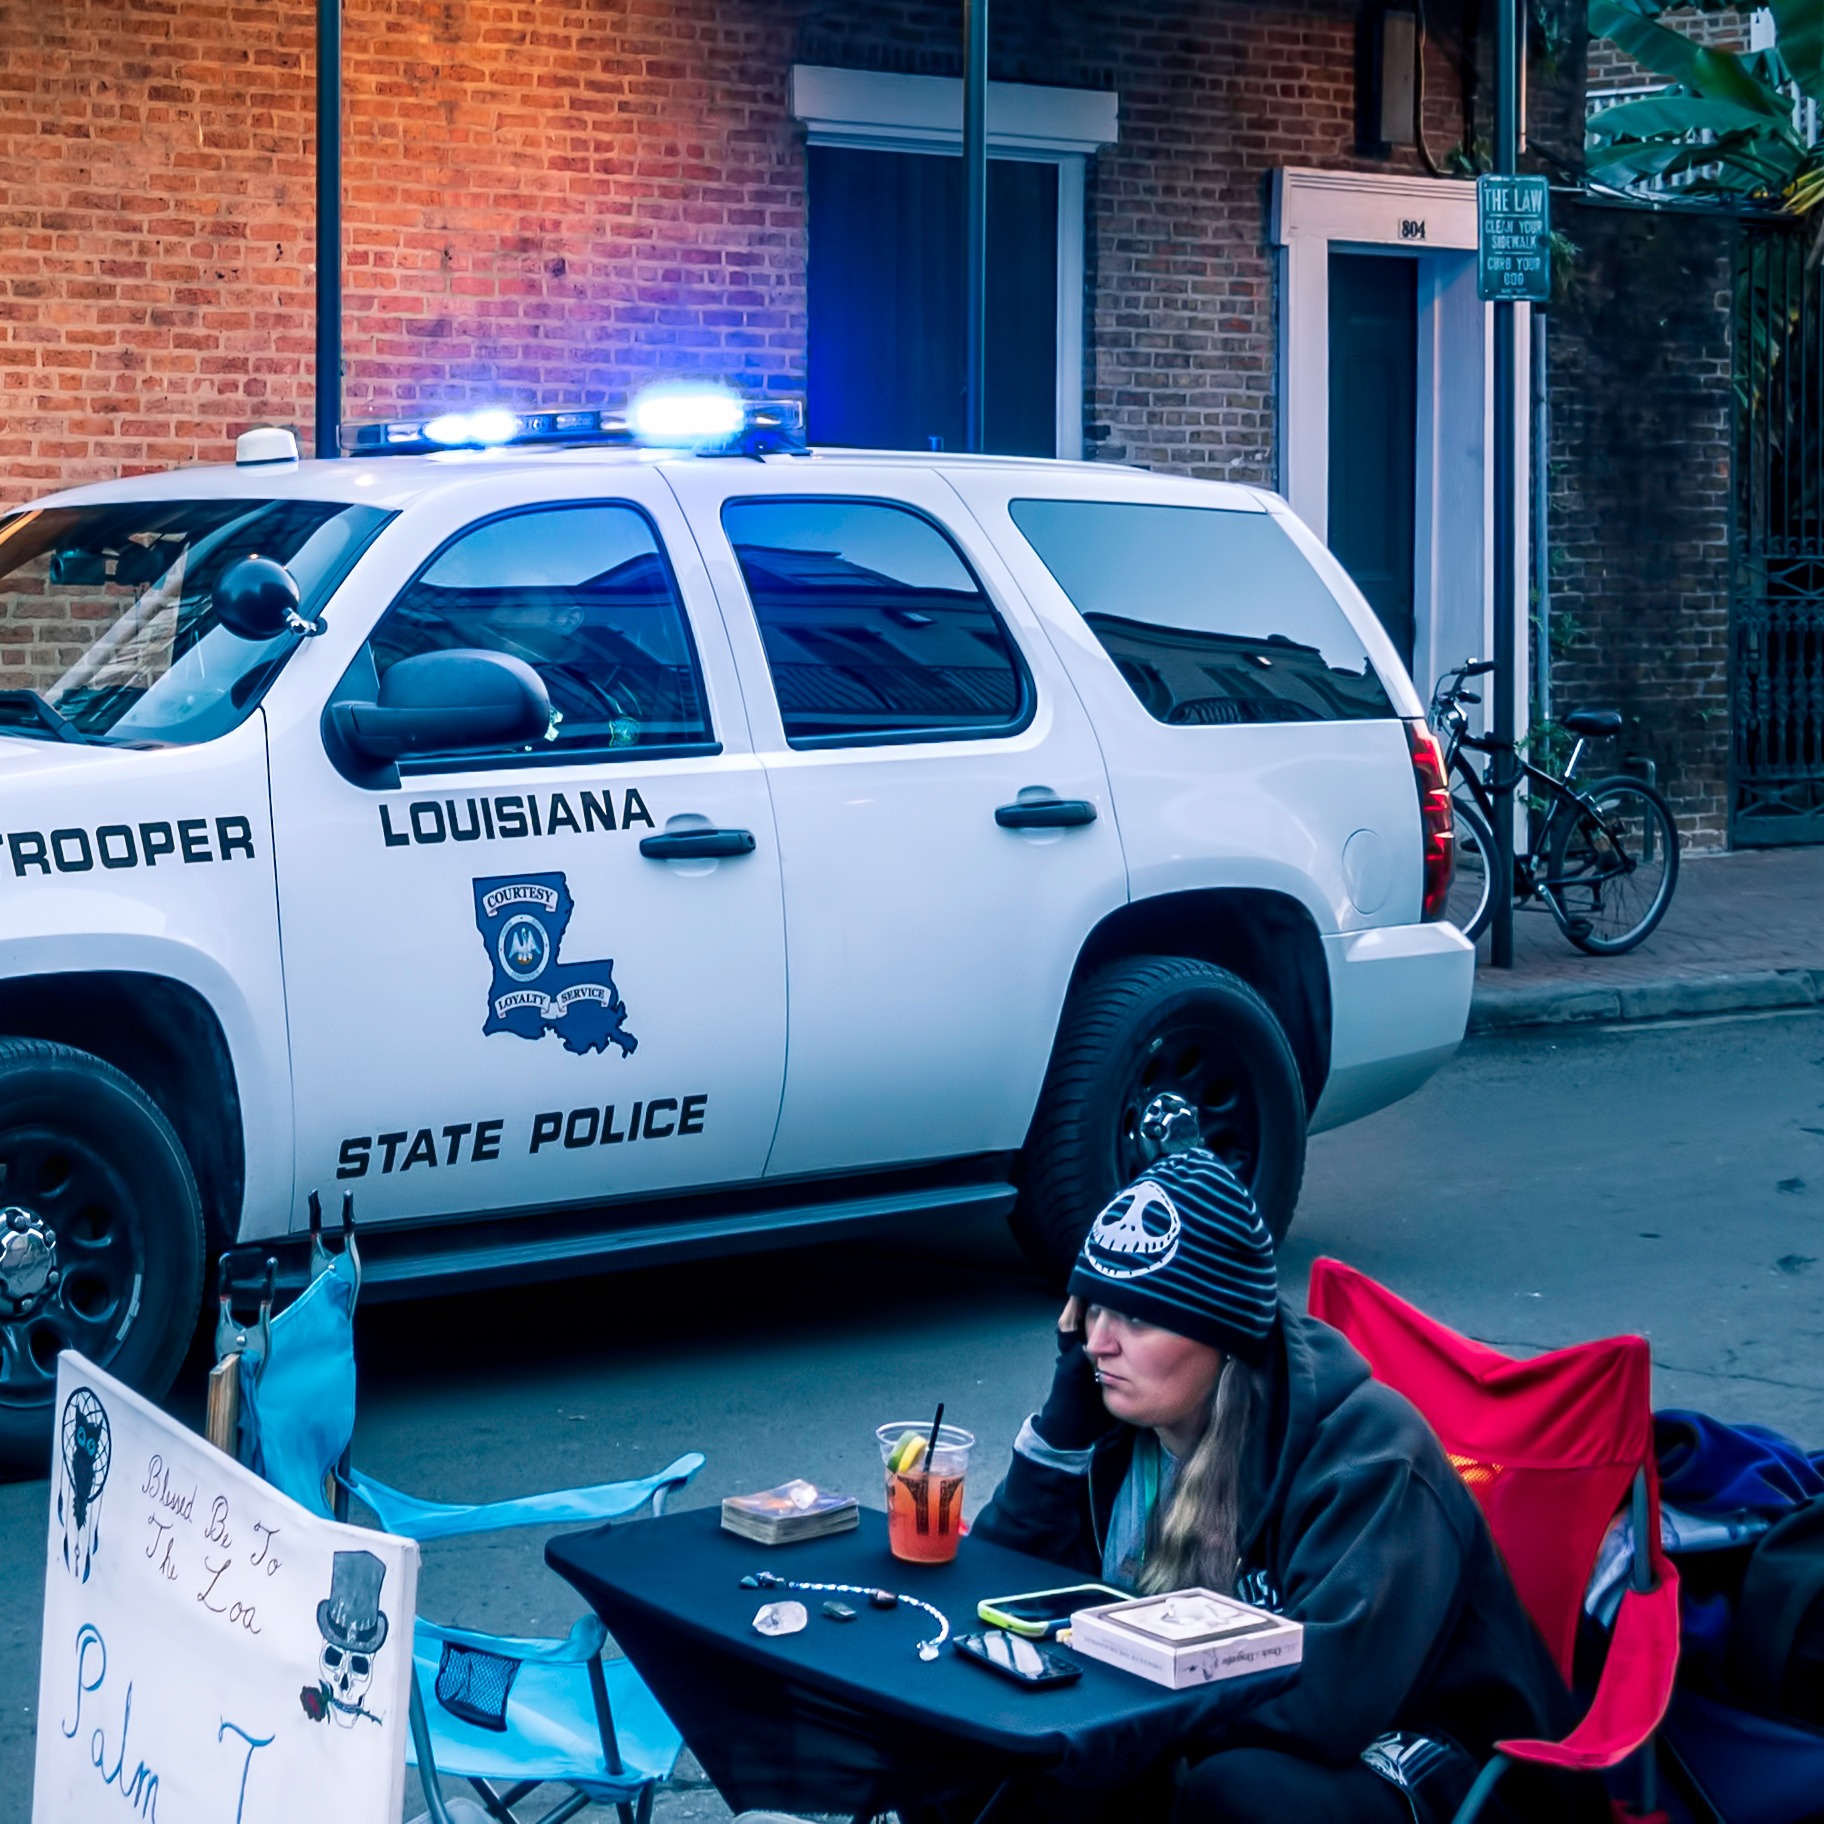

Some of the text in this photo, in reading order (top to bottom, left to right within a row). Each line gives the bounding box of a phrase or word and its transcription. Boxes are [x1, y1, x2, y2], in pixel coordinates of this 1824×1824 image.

[1484, 188, 1543, 212] THE LAW
[1402, 220, 1425, 238] 804
[1485, 219, 1543, 234] CLEAN YOUR
[1491, 235, 1537, 249] SIDEWALK
[1487, 257, 1541, 271] CURB YOUR
[378, 788, 656, 848] LOUISIANA
[487, 885, 554, 909] COURTESY
[498, 987, 605, 1011] LOYALTY SERVICE
[335, 1093, 709, 1180] STATE POLICE
[141, 1454, 283, 1576] Blessed Be To
[146, 1512, 262, 1634] The Loa
[62, 1623, 159, 1824] Palm
